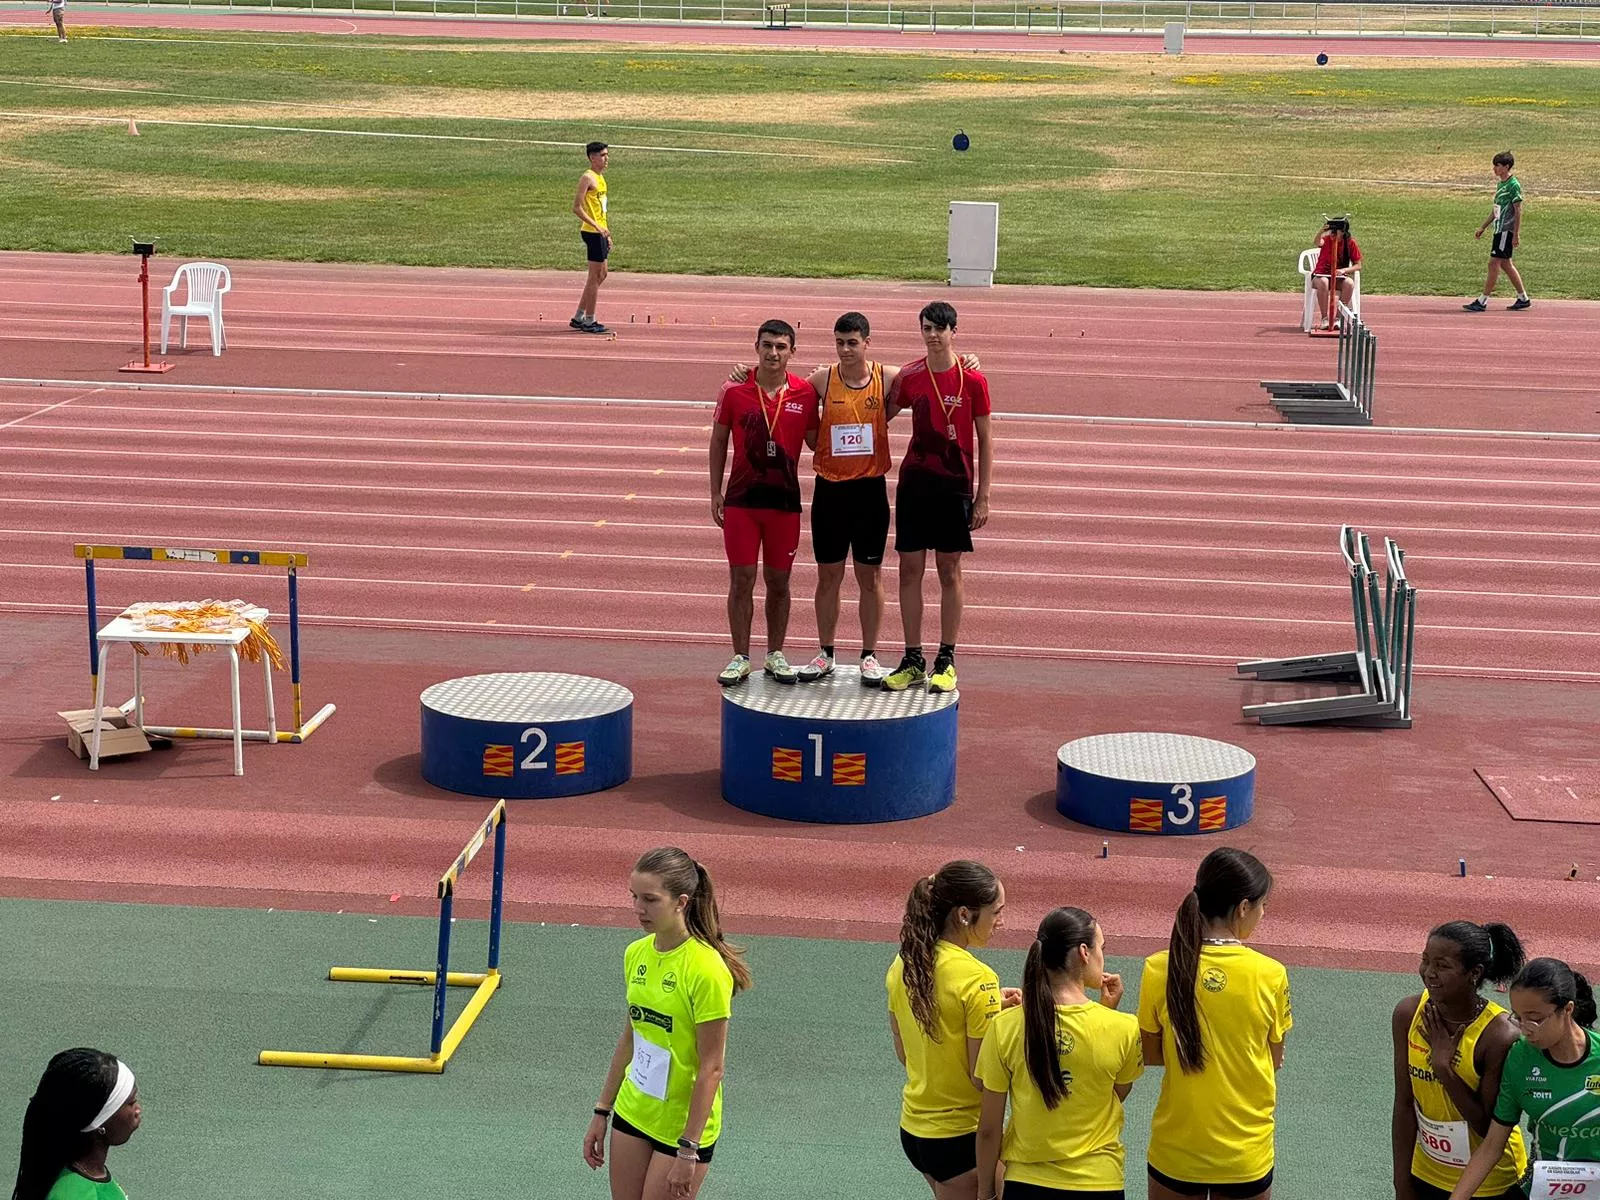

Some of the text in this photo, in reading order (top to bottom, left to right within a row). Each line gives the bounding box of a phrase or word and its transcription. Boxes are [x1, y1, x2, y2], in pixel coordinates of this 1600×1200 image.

[785, 402, 803, 411] ZGZ
[944, 395, 963, 403] ZGZ
[840, 434, 863, 445] 120
[520, 727, 548, 770] 2
[808, 733, 823, 777] 1
[1167, 783, 1195, 825] 3
[1421, 1128, 1452, 1153] 580
[1548, 1182, 1586, 1196] 790
